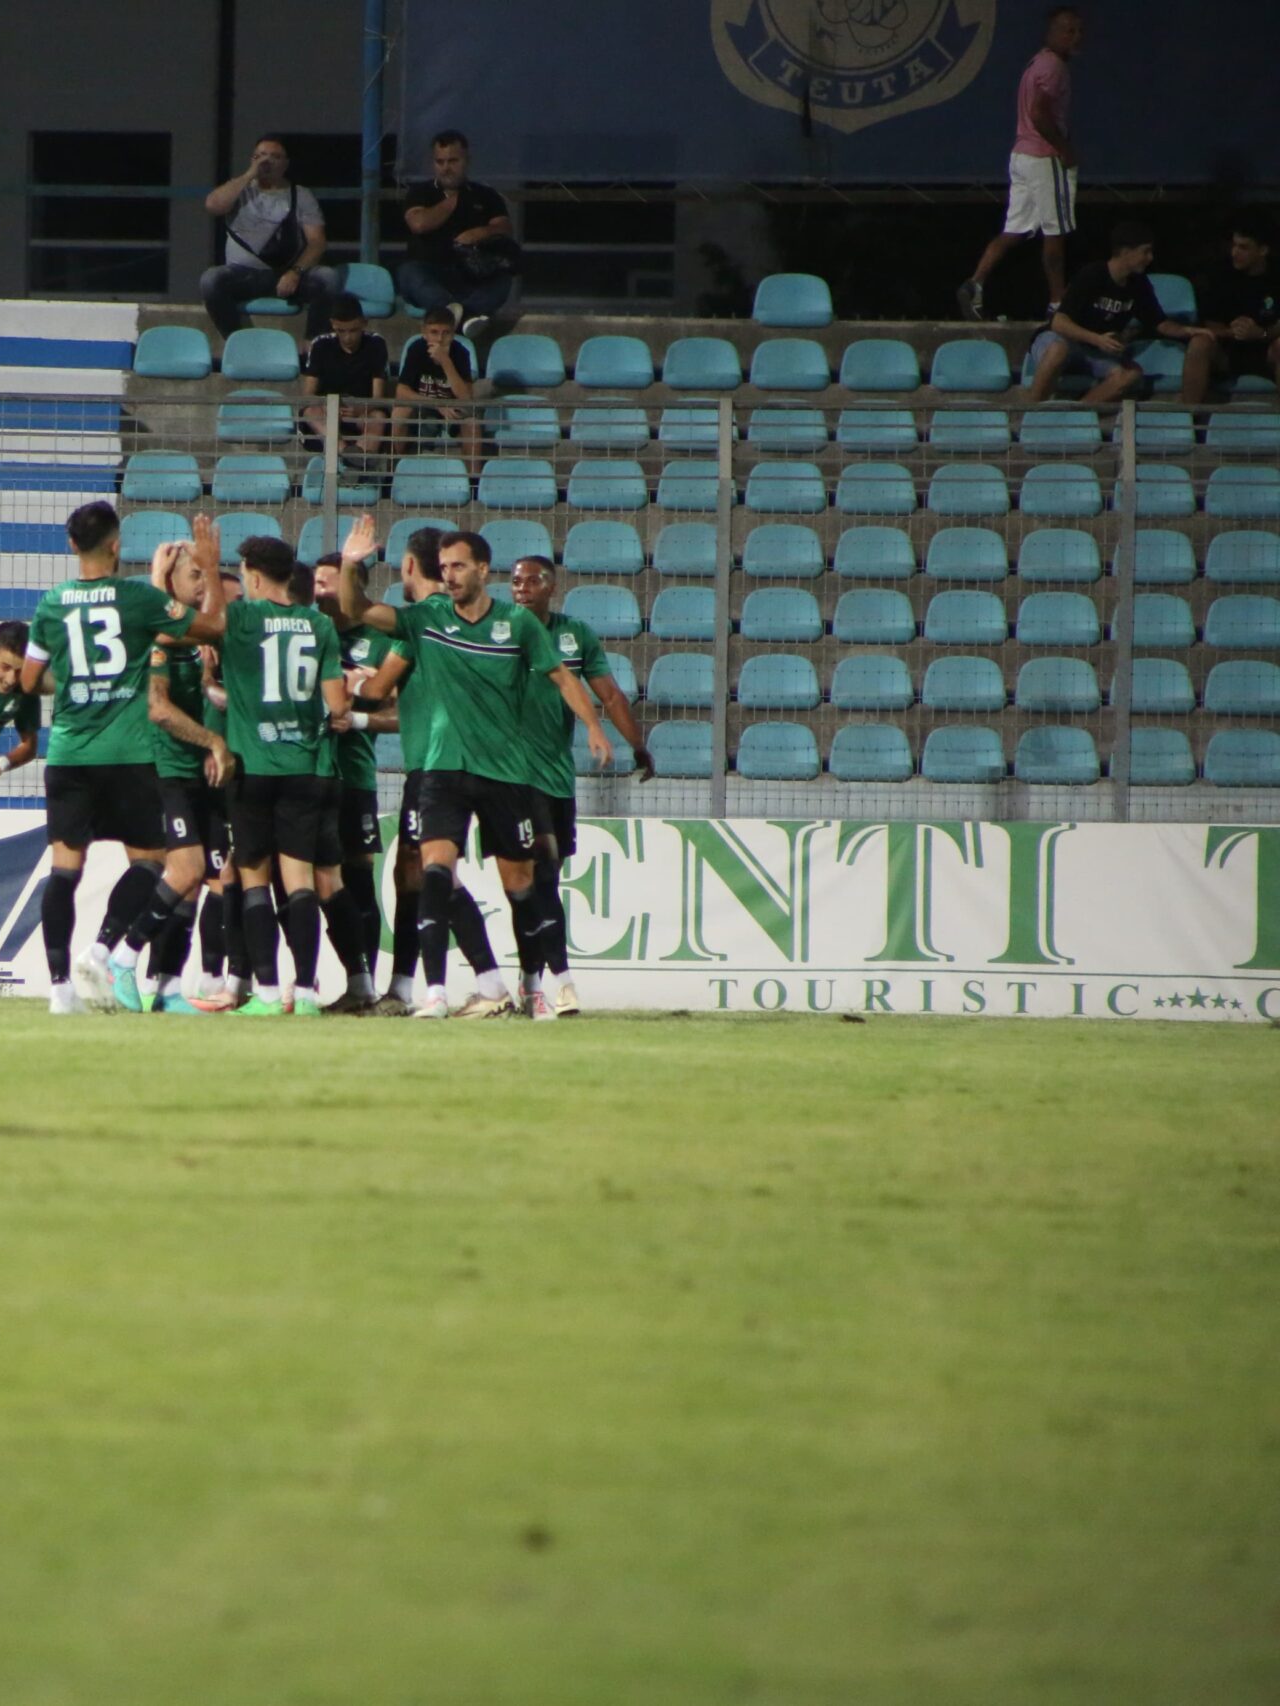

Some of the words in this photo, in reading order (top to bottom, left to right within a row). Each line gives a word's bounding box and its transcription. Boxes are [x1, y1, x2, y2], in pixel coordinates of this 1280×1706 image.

[778, 55, 934, 104] TEUTA
[61, 586, 116, 606] MALOTA
[63, 607, 127, 676] 13
[259, 633, 319, 702] 16
[173, 817, 187, 838] 9
[517, 818, 534, 842] 19
[211, 850, 224, 869] 6
[708, 978, 1140, 1017] TOURISTIC
